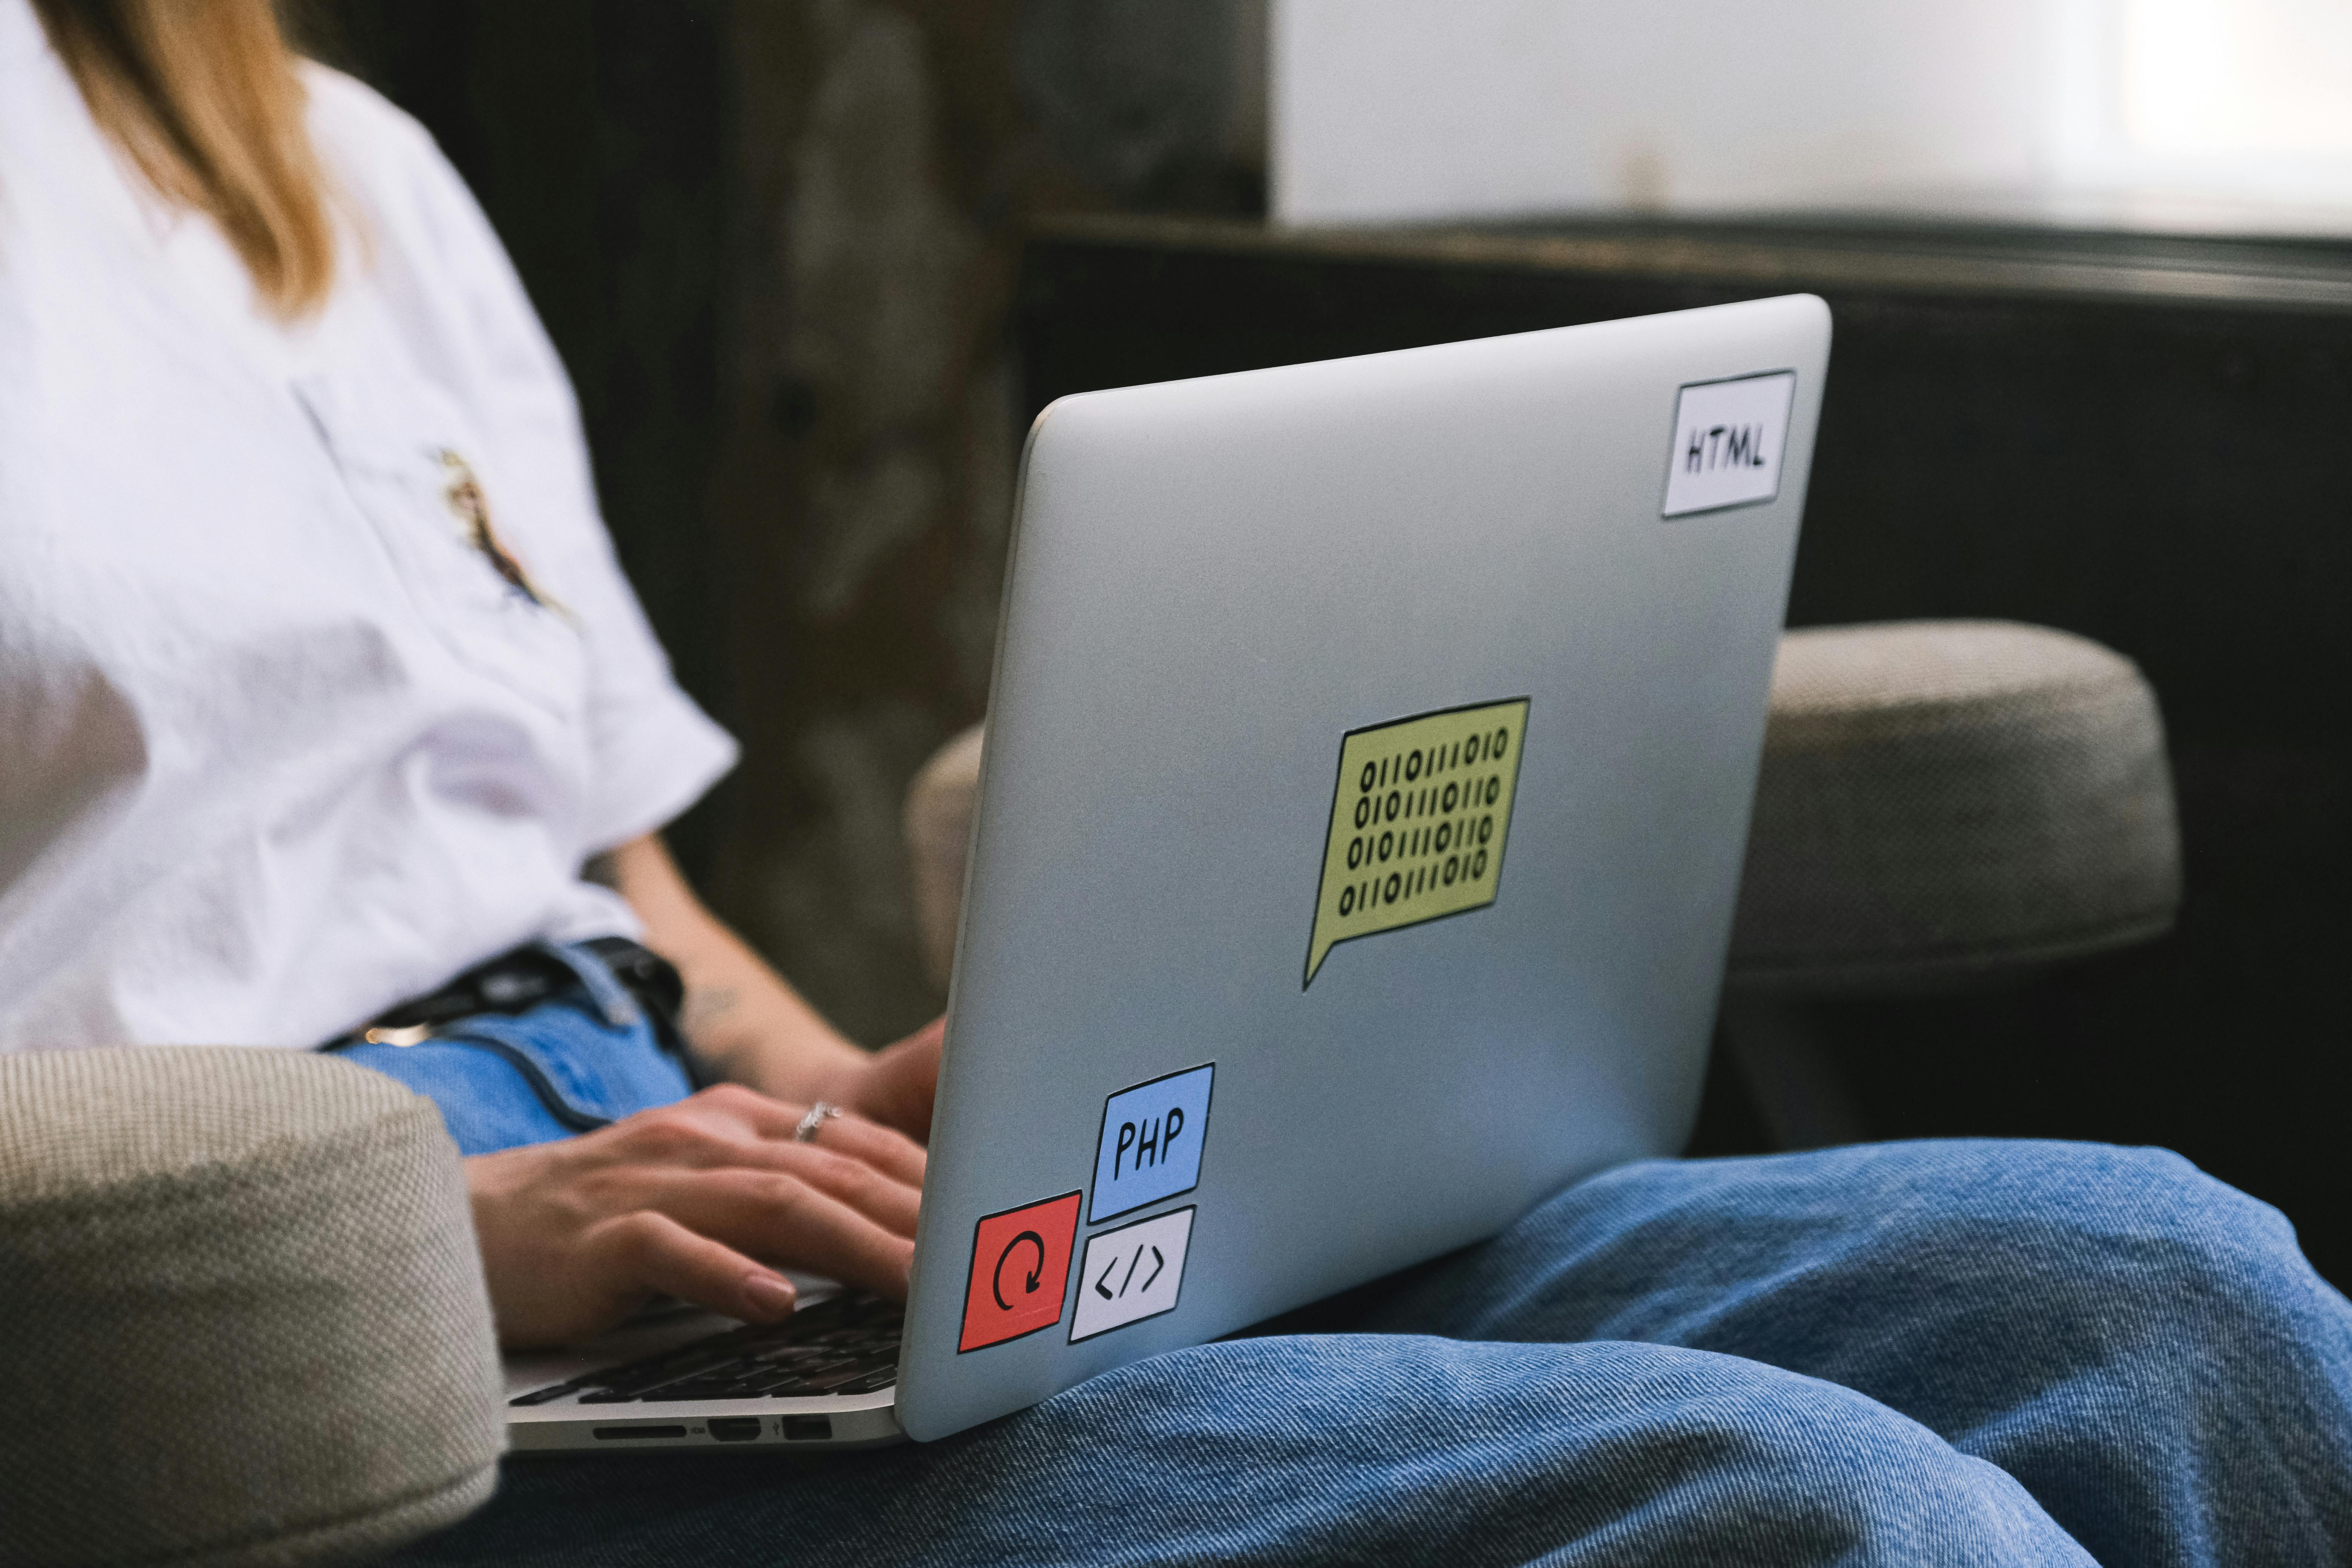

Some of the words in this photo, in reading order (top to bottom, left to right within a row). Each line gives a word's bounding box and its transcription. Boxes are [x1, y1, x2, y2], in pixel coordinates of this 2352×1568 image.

[1686, 423, 1765, 474] HTML
[1360, 727, 1508, 793] 0110111010
[1355, 775, 1501, 829] 0101110110
[1348, 814, 1493, 870] 0101110110
[1339, 849, 1487, 916] 0110111010
[1114, 1107, 1184, 1181] PHP
